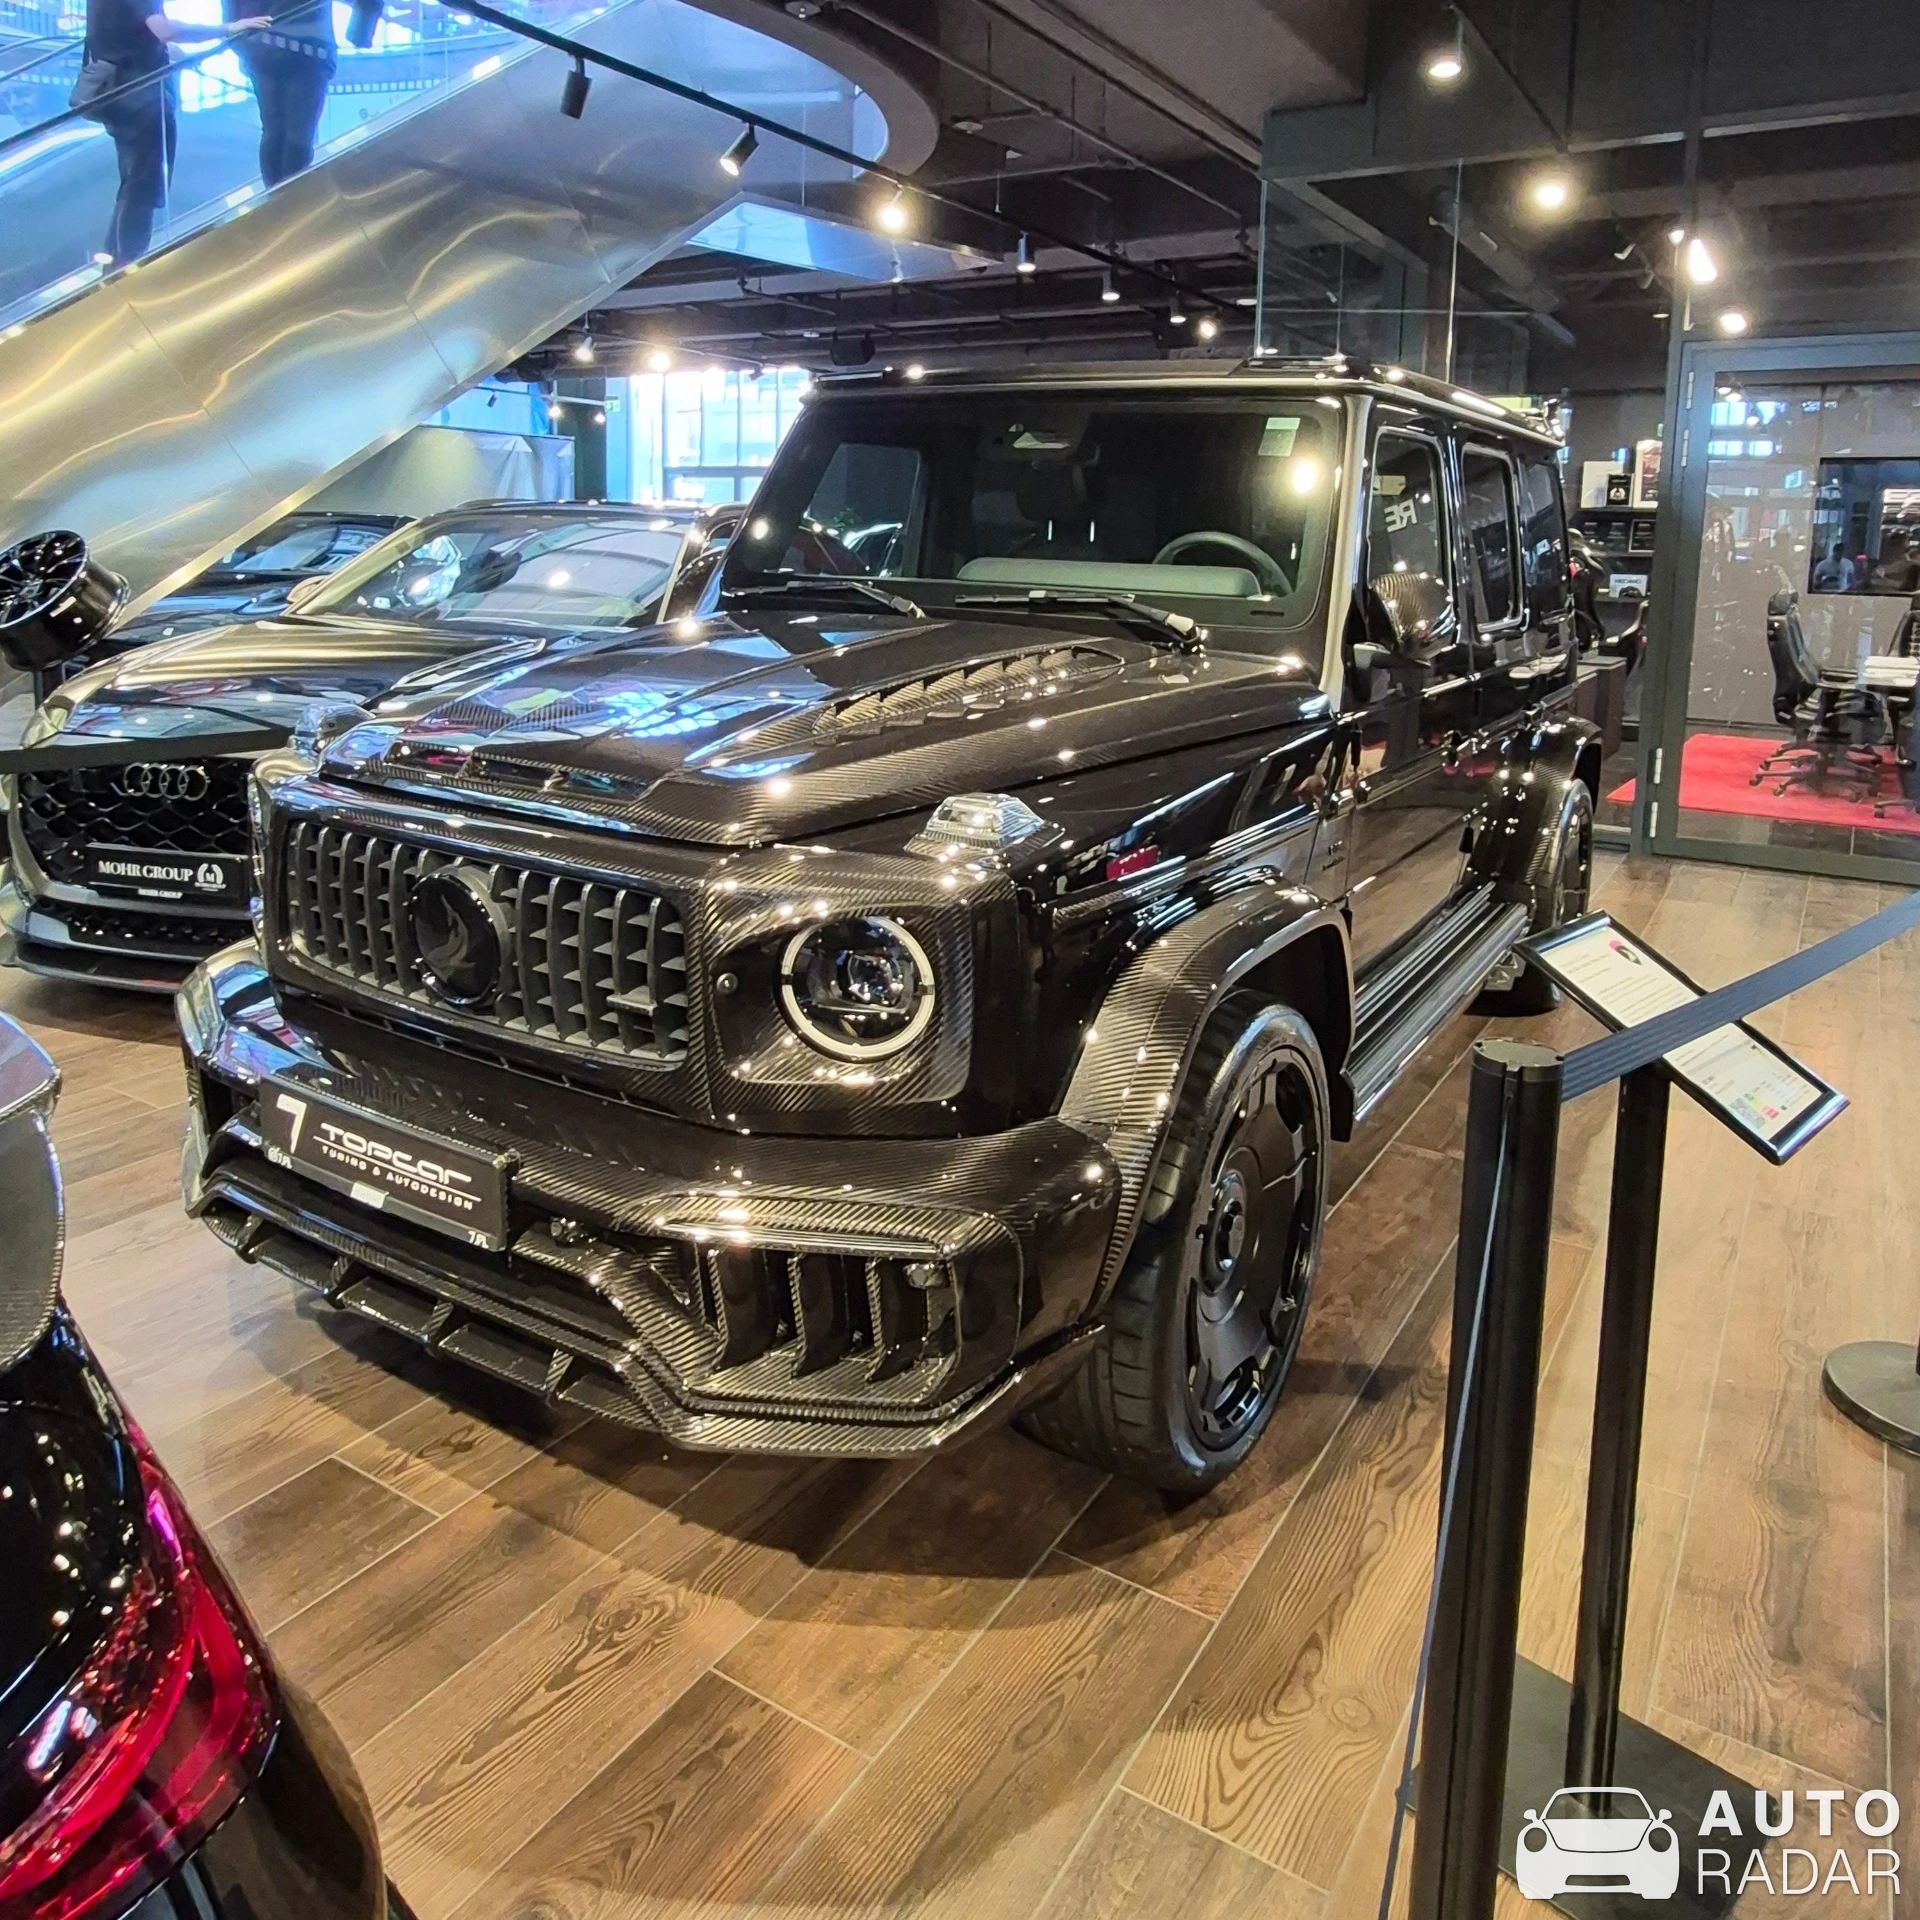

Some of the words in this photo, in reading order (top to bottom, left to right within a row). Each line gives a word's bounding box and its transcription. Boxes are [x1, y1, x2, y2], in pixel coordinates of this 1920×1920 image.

[98, 860, 142, 877] MOHR
[142, 864, 194, 882] GROUP
[322, 1145, 367, 1171] TUNING
[386, 1171, 473, 1211] AUTODESIGN
